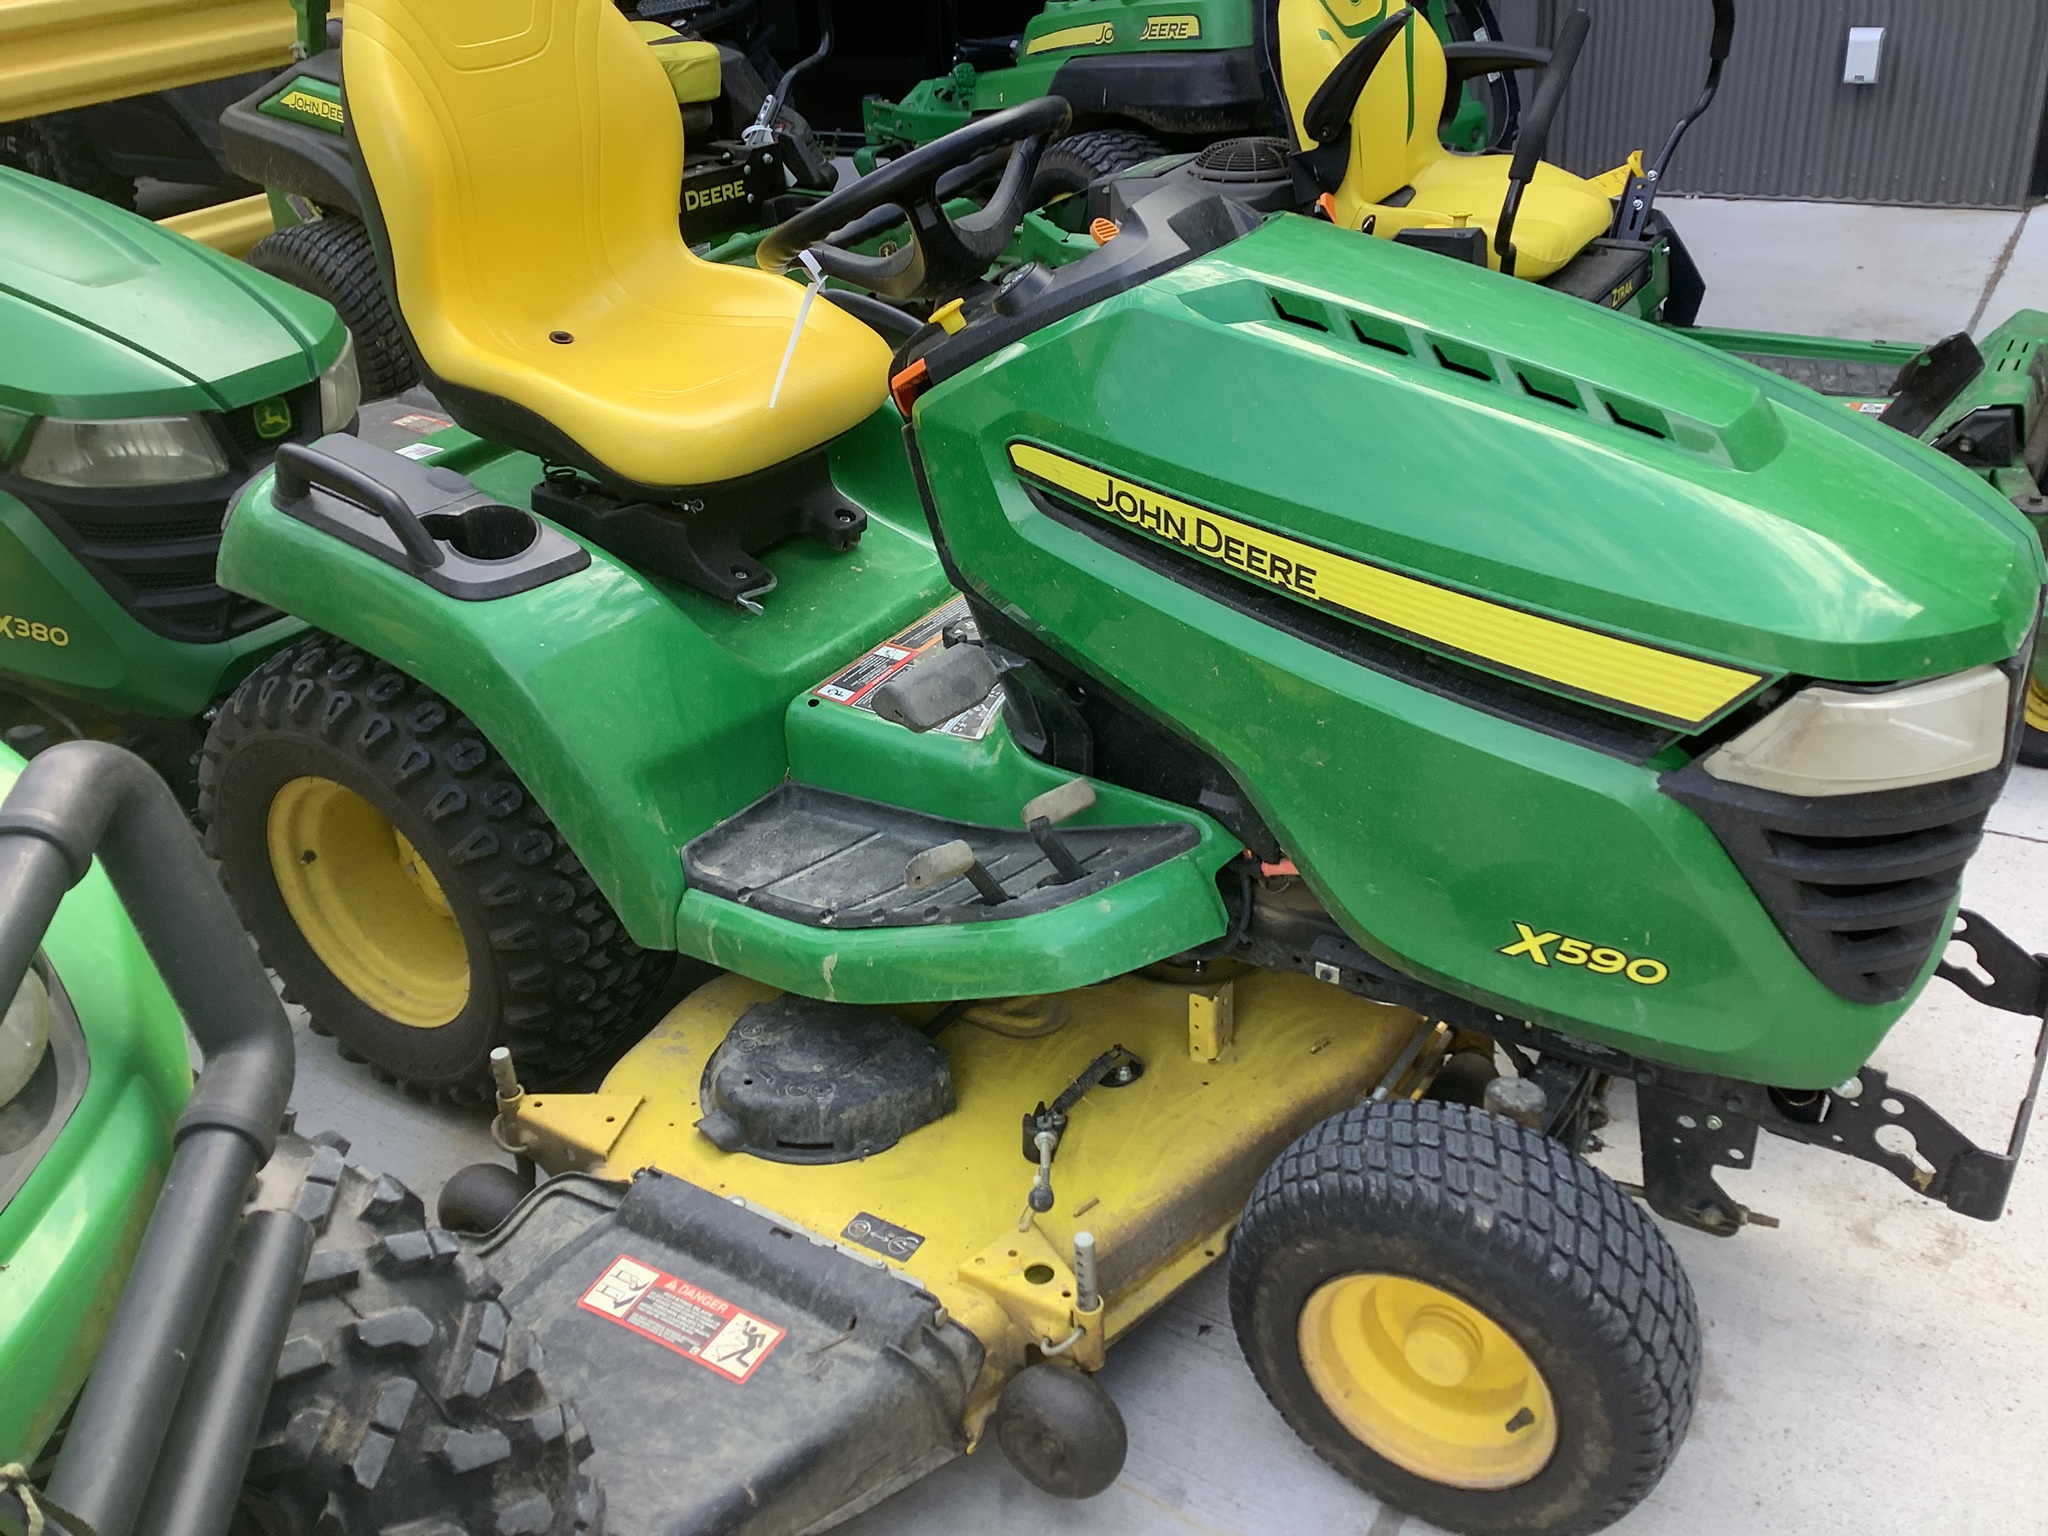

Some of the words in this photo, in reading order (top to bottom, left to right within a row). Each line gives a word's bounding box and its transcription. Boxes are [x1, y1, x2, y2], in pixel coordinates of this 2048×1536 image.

[1141, 22, 1189, 37] EERE
[291, 94, 319, 114] JOHN
[321, 103, 343, 120] DEE
[684, 180, 746, 212] DEERE
[1096, 479, 1186, 541] JOHN
[1196, 517, 1317, 595] DEERE
[0, 614, 69, 647] X380
[1497, 920, 1669, 985] X590
[678, 1284, 729, 1314] DANGER
